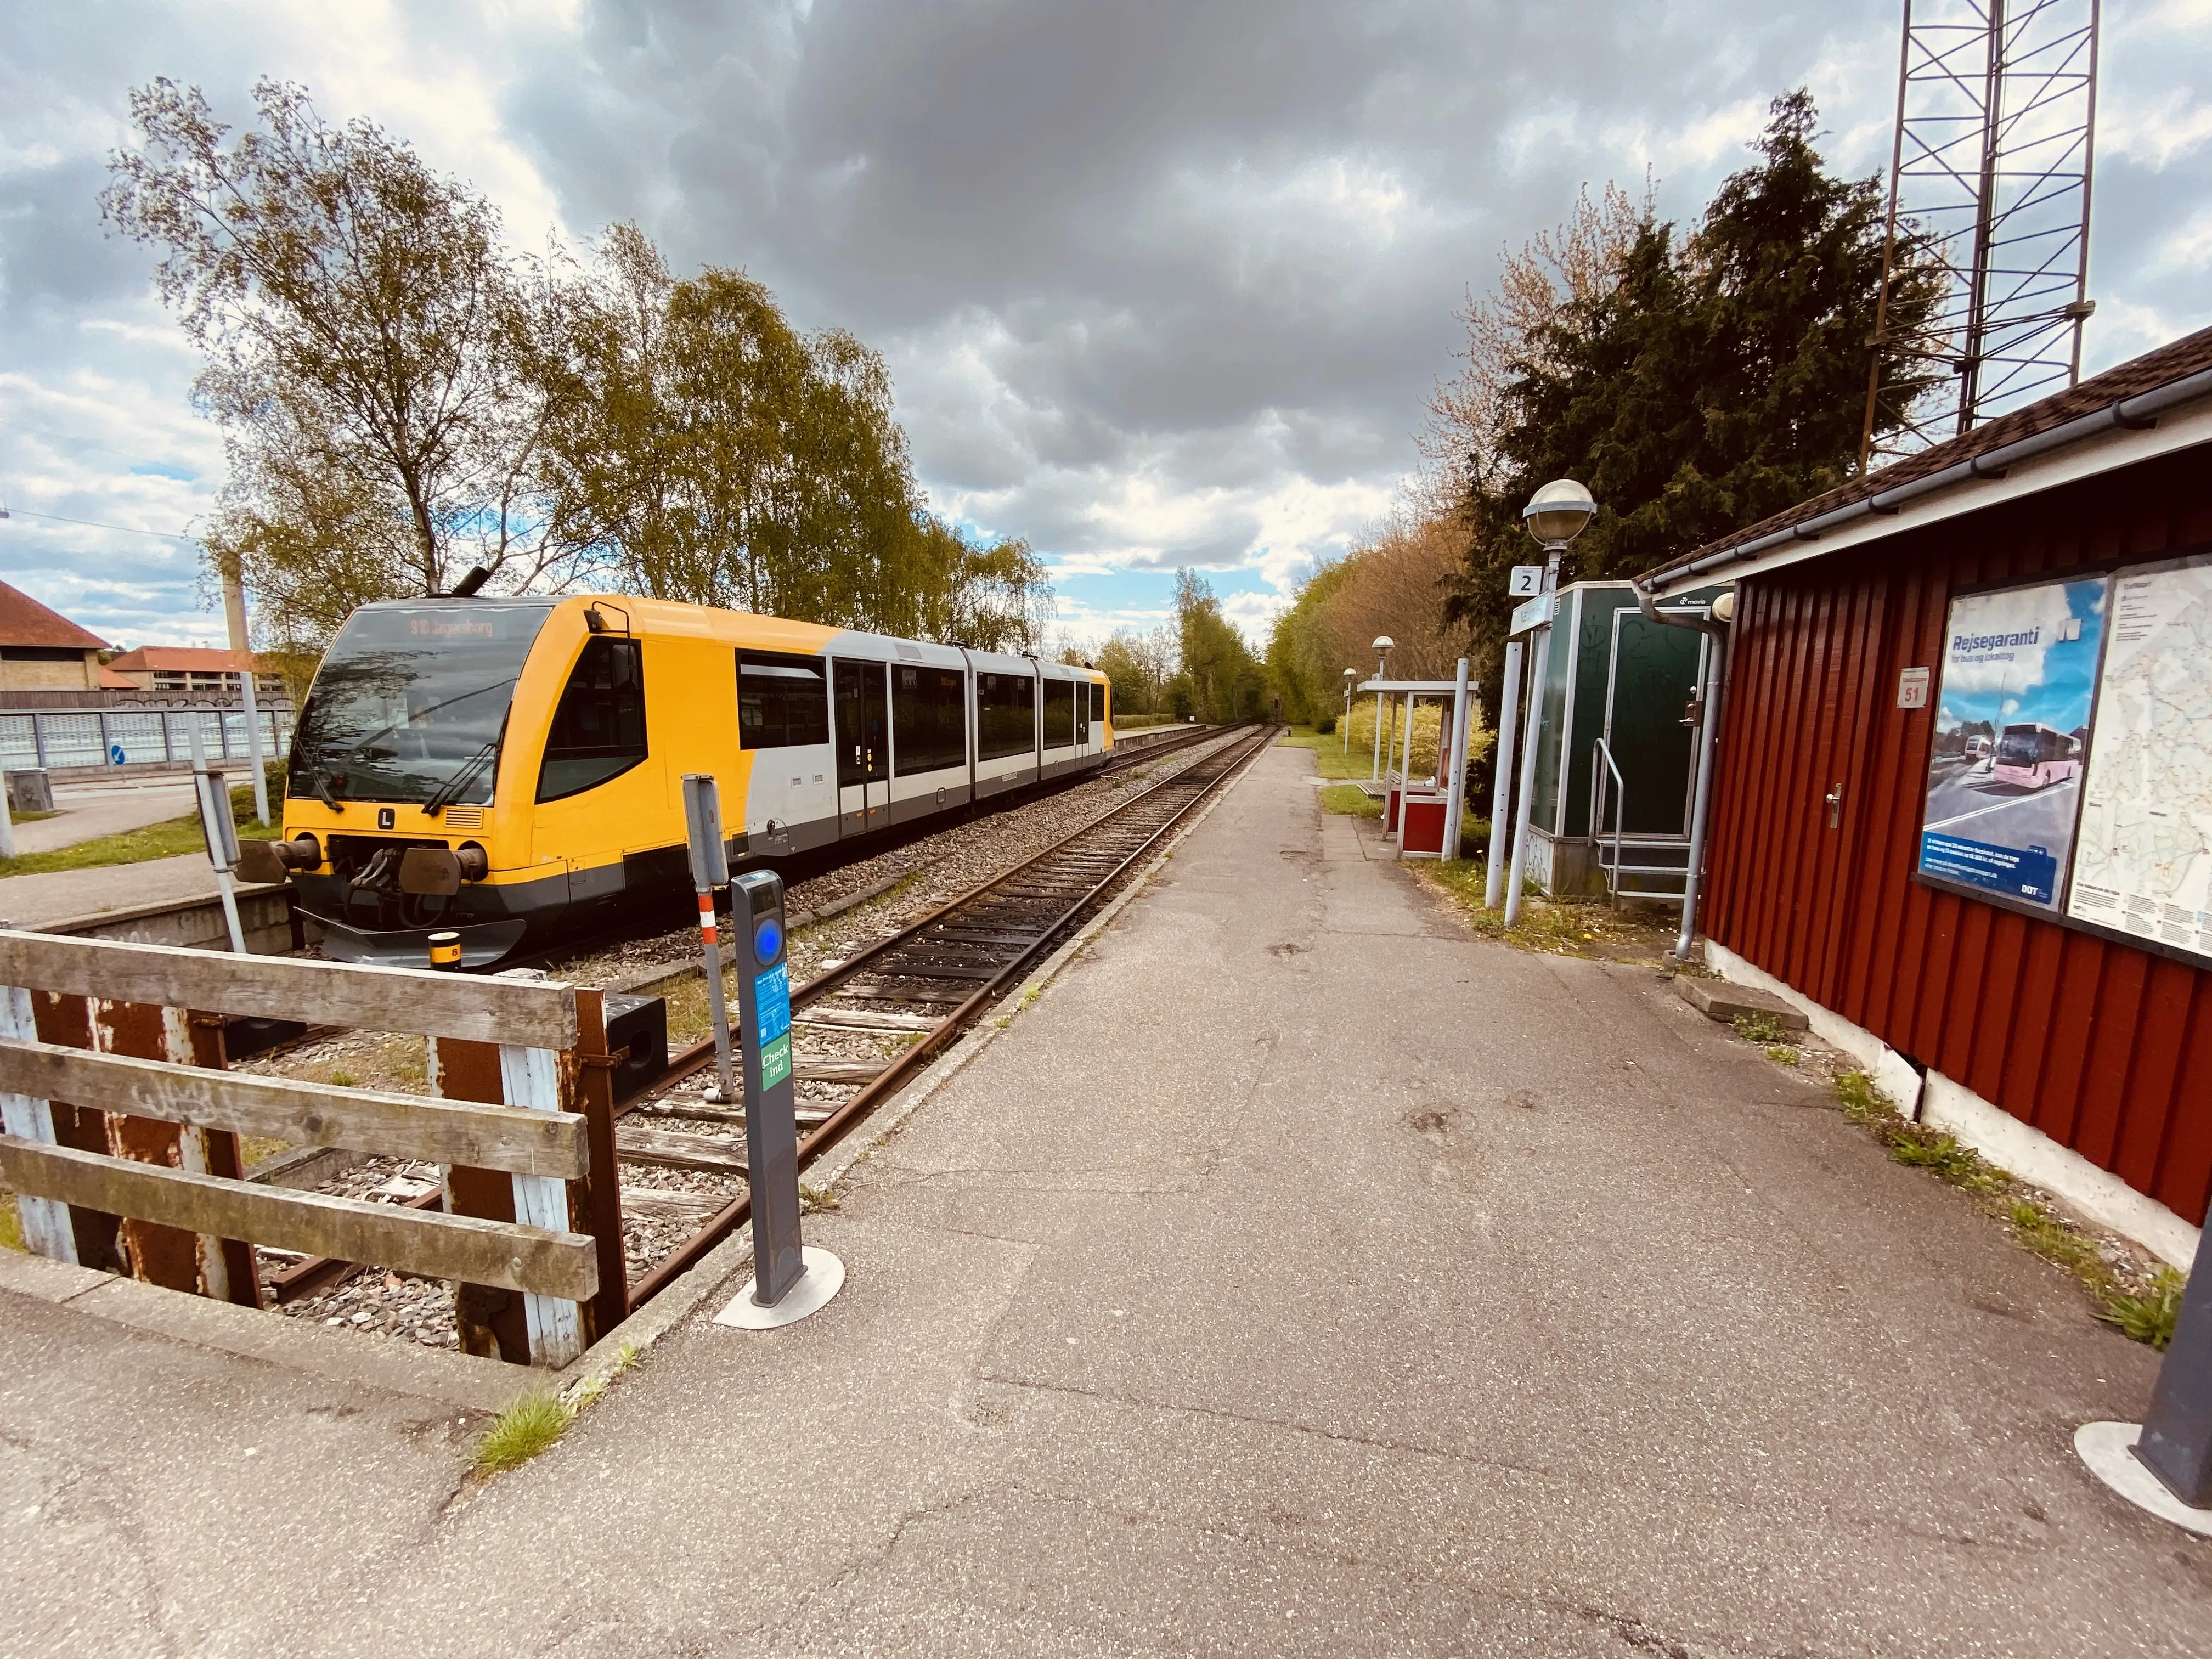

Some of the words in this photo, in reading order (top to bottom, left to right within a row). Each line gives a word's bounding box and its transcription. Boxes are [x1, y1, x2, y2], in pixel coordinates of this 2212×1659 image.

[1521, 575, 1531, 591] 2
[1953, 626, 2039, 653] Rejsegaranti
[1961, 653, 1973, 662] bus
[1975, 655, 1984, 663] og
[1905, 687, 1919, 702] 51
[382, 812, 391, 826] L
[2021, 884, 2038, 895] DOT
[762, 1044, 789, 1069] Check
[770, 1060, 783, 1078] ind
